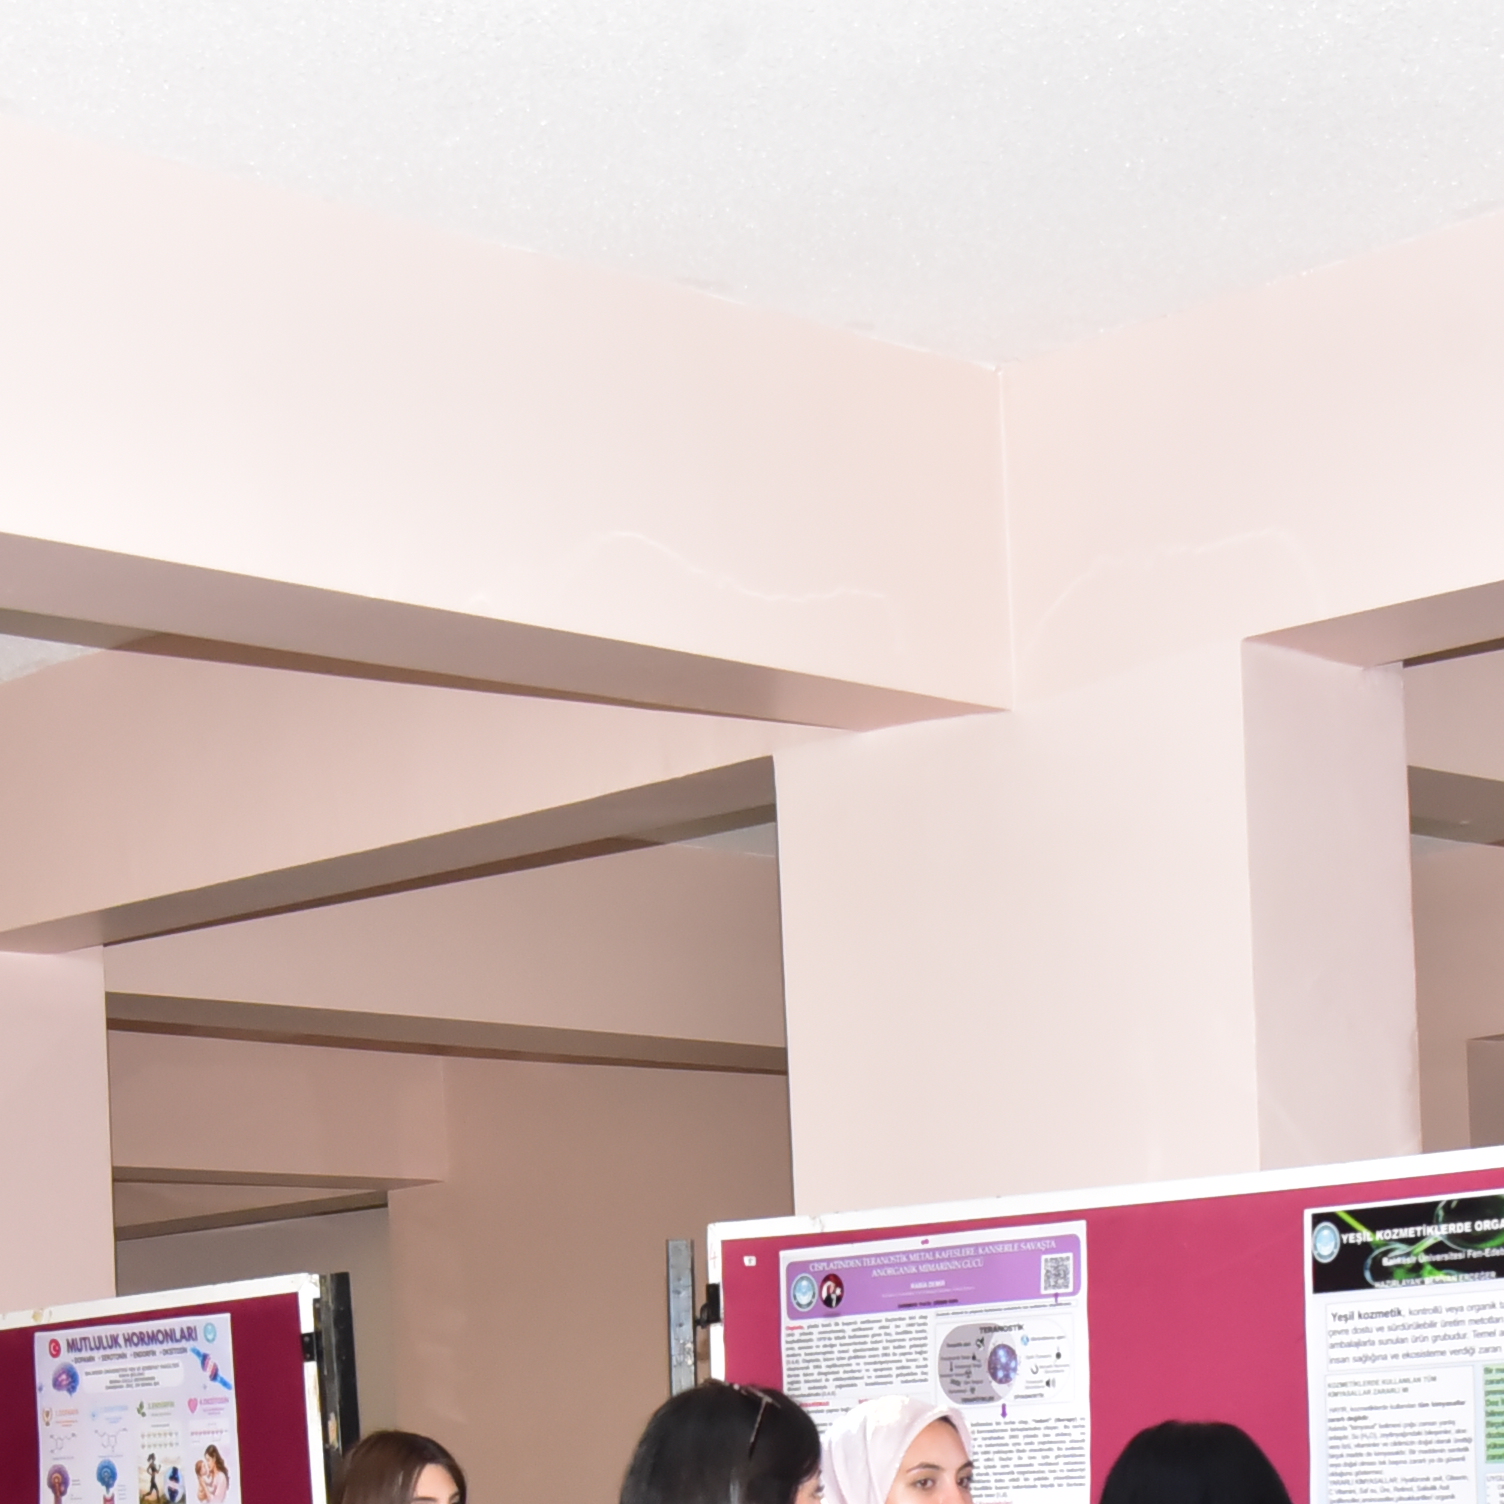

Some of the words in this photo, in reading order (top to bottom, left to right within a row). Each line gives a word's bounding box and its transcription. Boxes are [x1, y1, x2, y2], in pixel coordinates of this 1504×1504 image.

[1376, 1221, 1472, 1242] KOZMETİKLERDE
[66, 1333, 121, 1353] MUTLULUK
[122, 1325, 198, 1348] HORMONLARI
